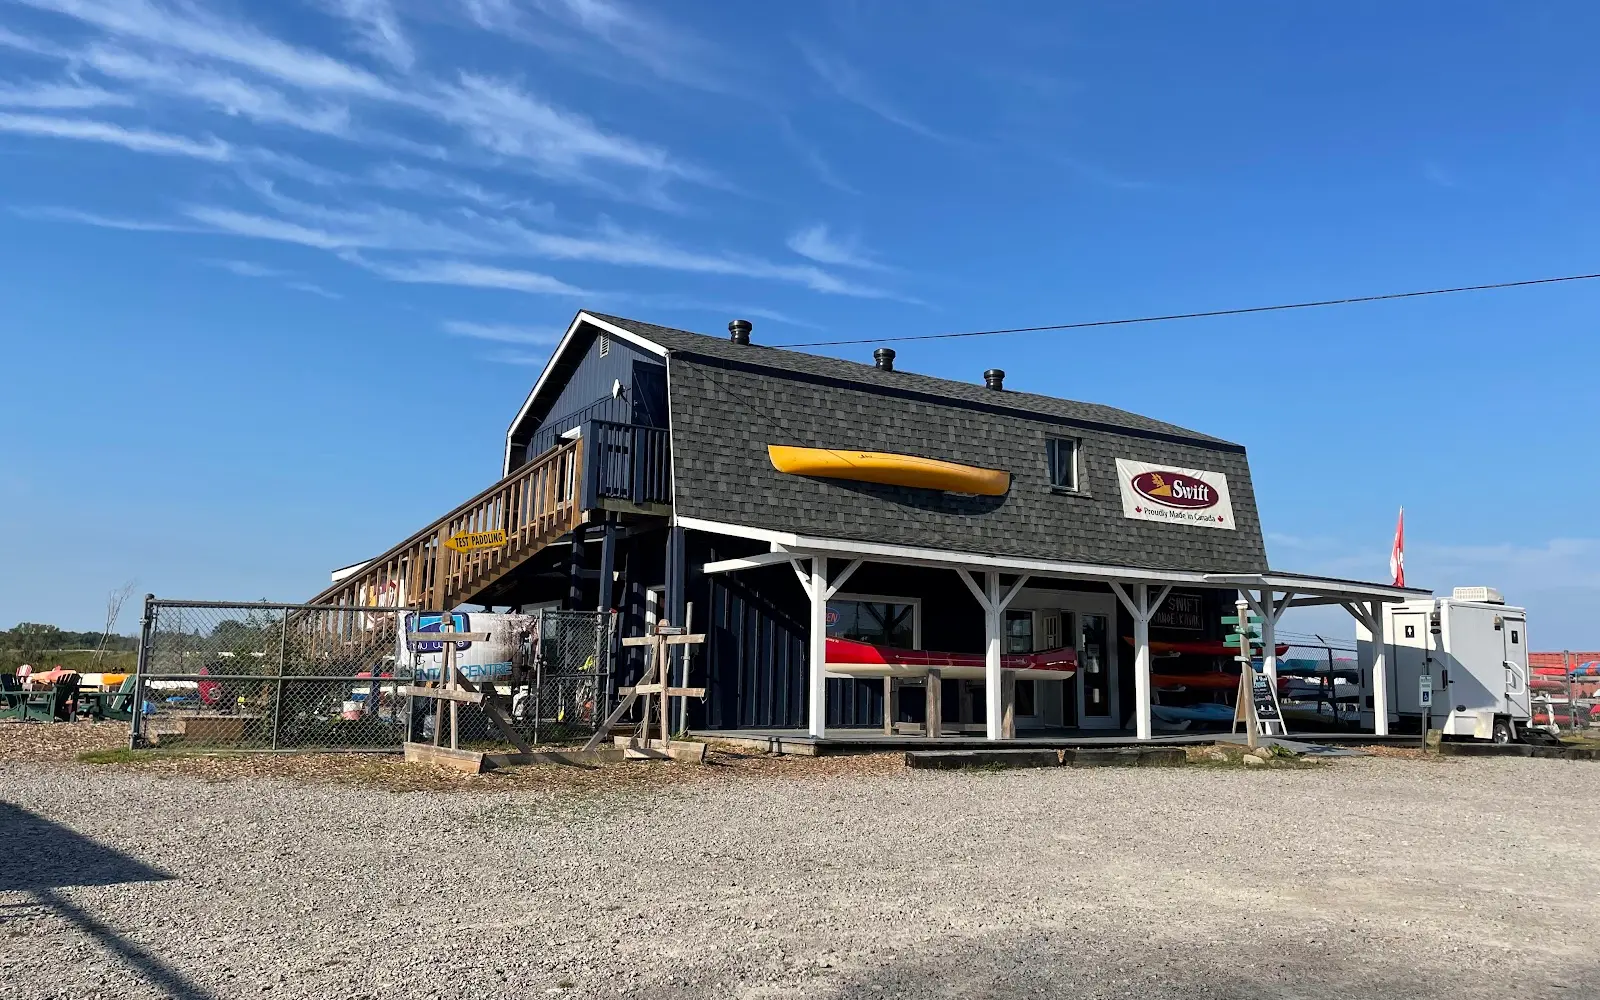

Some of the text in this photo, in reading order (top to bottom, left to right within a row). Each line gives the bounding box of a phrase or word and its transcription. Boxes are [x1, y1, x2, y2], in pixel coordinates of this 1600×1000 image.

[1172, 479, 1209, 502] Swift
[1143, 506, 1216, 522] Proudly Made in Canada
[455, 532, 503, 548] TEST PADDLING
[1168, 596, 1200, 612] SWIFT
[459, 662, 513, 679] CENTRE
